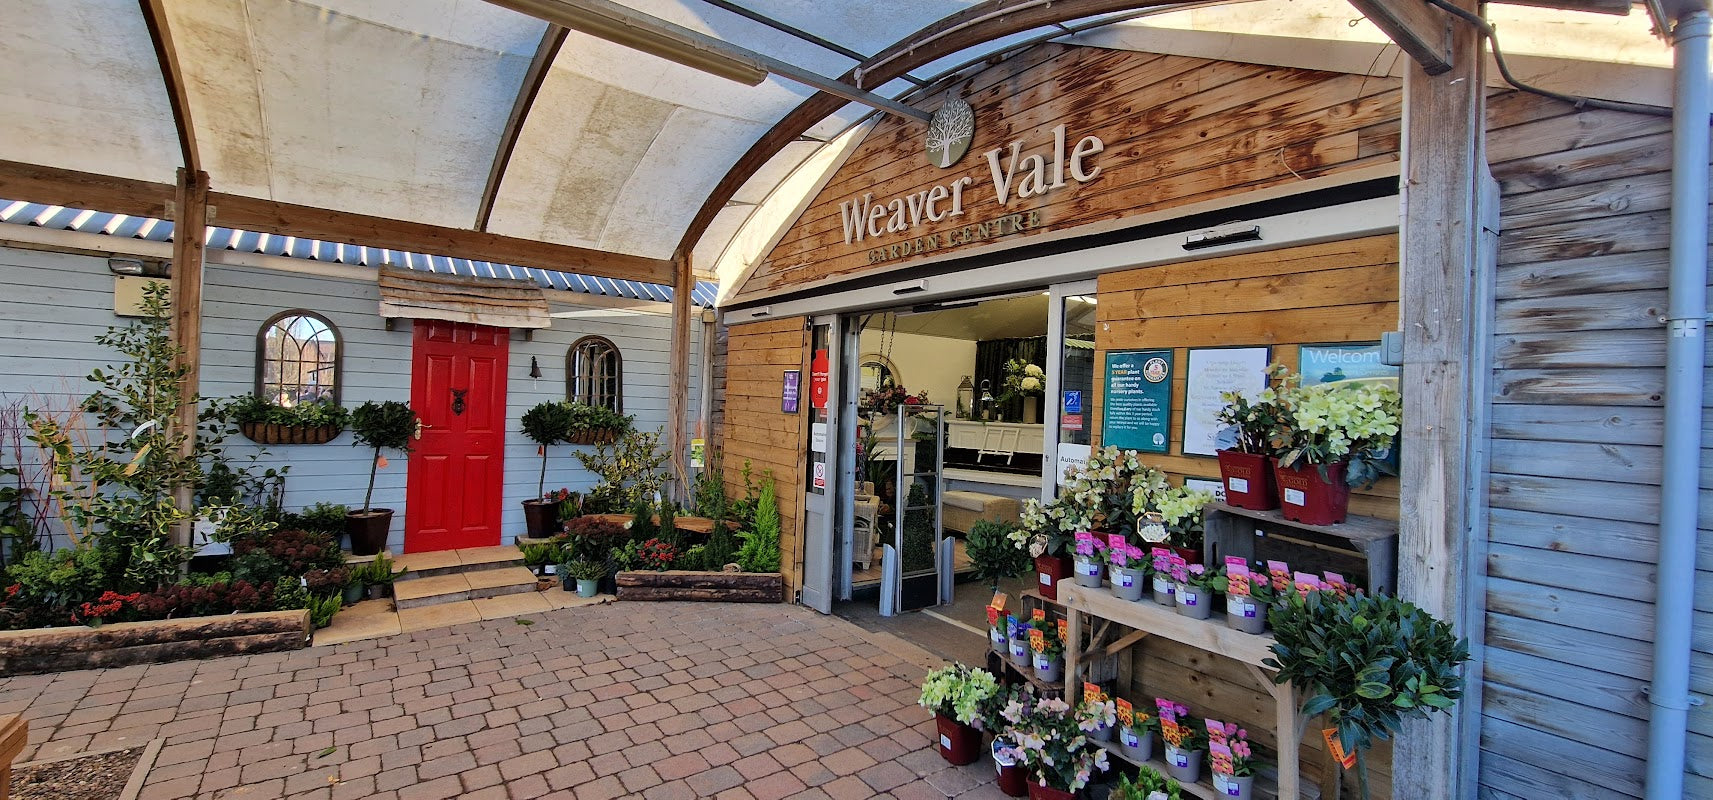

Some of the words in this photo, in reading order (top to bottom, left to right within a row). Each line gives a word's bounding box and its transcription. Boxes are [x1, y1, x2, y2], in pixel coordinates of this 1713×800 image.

[839, 176, 973, 245] Weaver
[983, 123, 1104, 206] Vale
[868, 234, 940, 264] GARDEN
[949, 209, 1041, 246] CENTRE
[1310, 349, 1380, 364] Welcom
